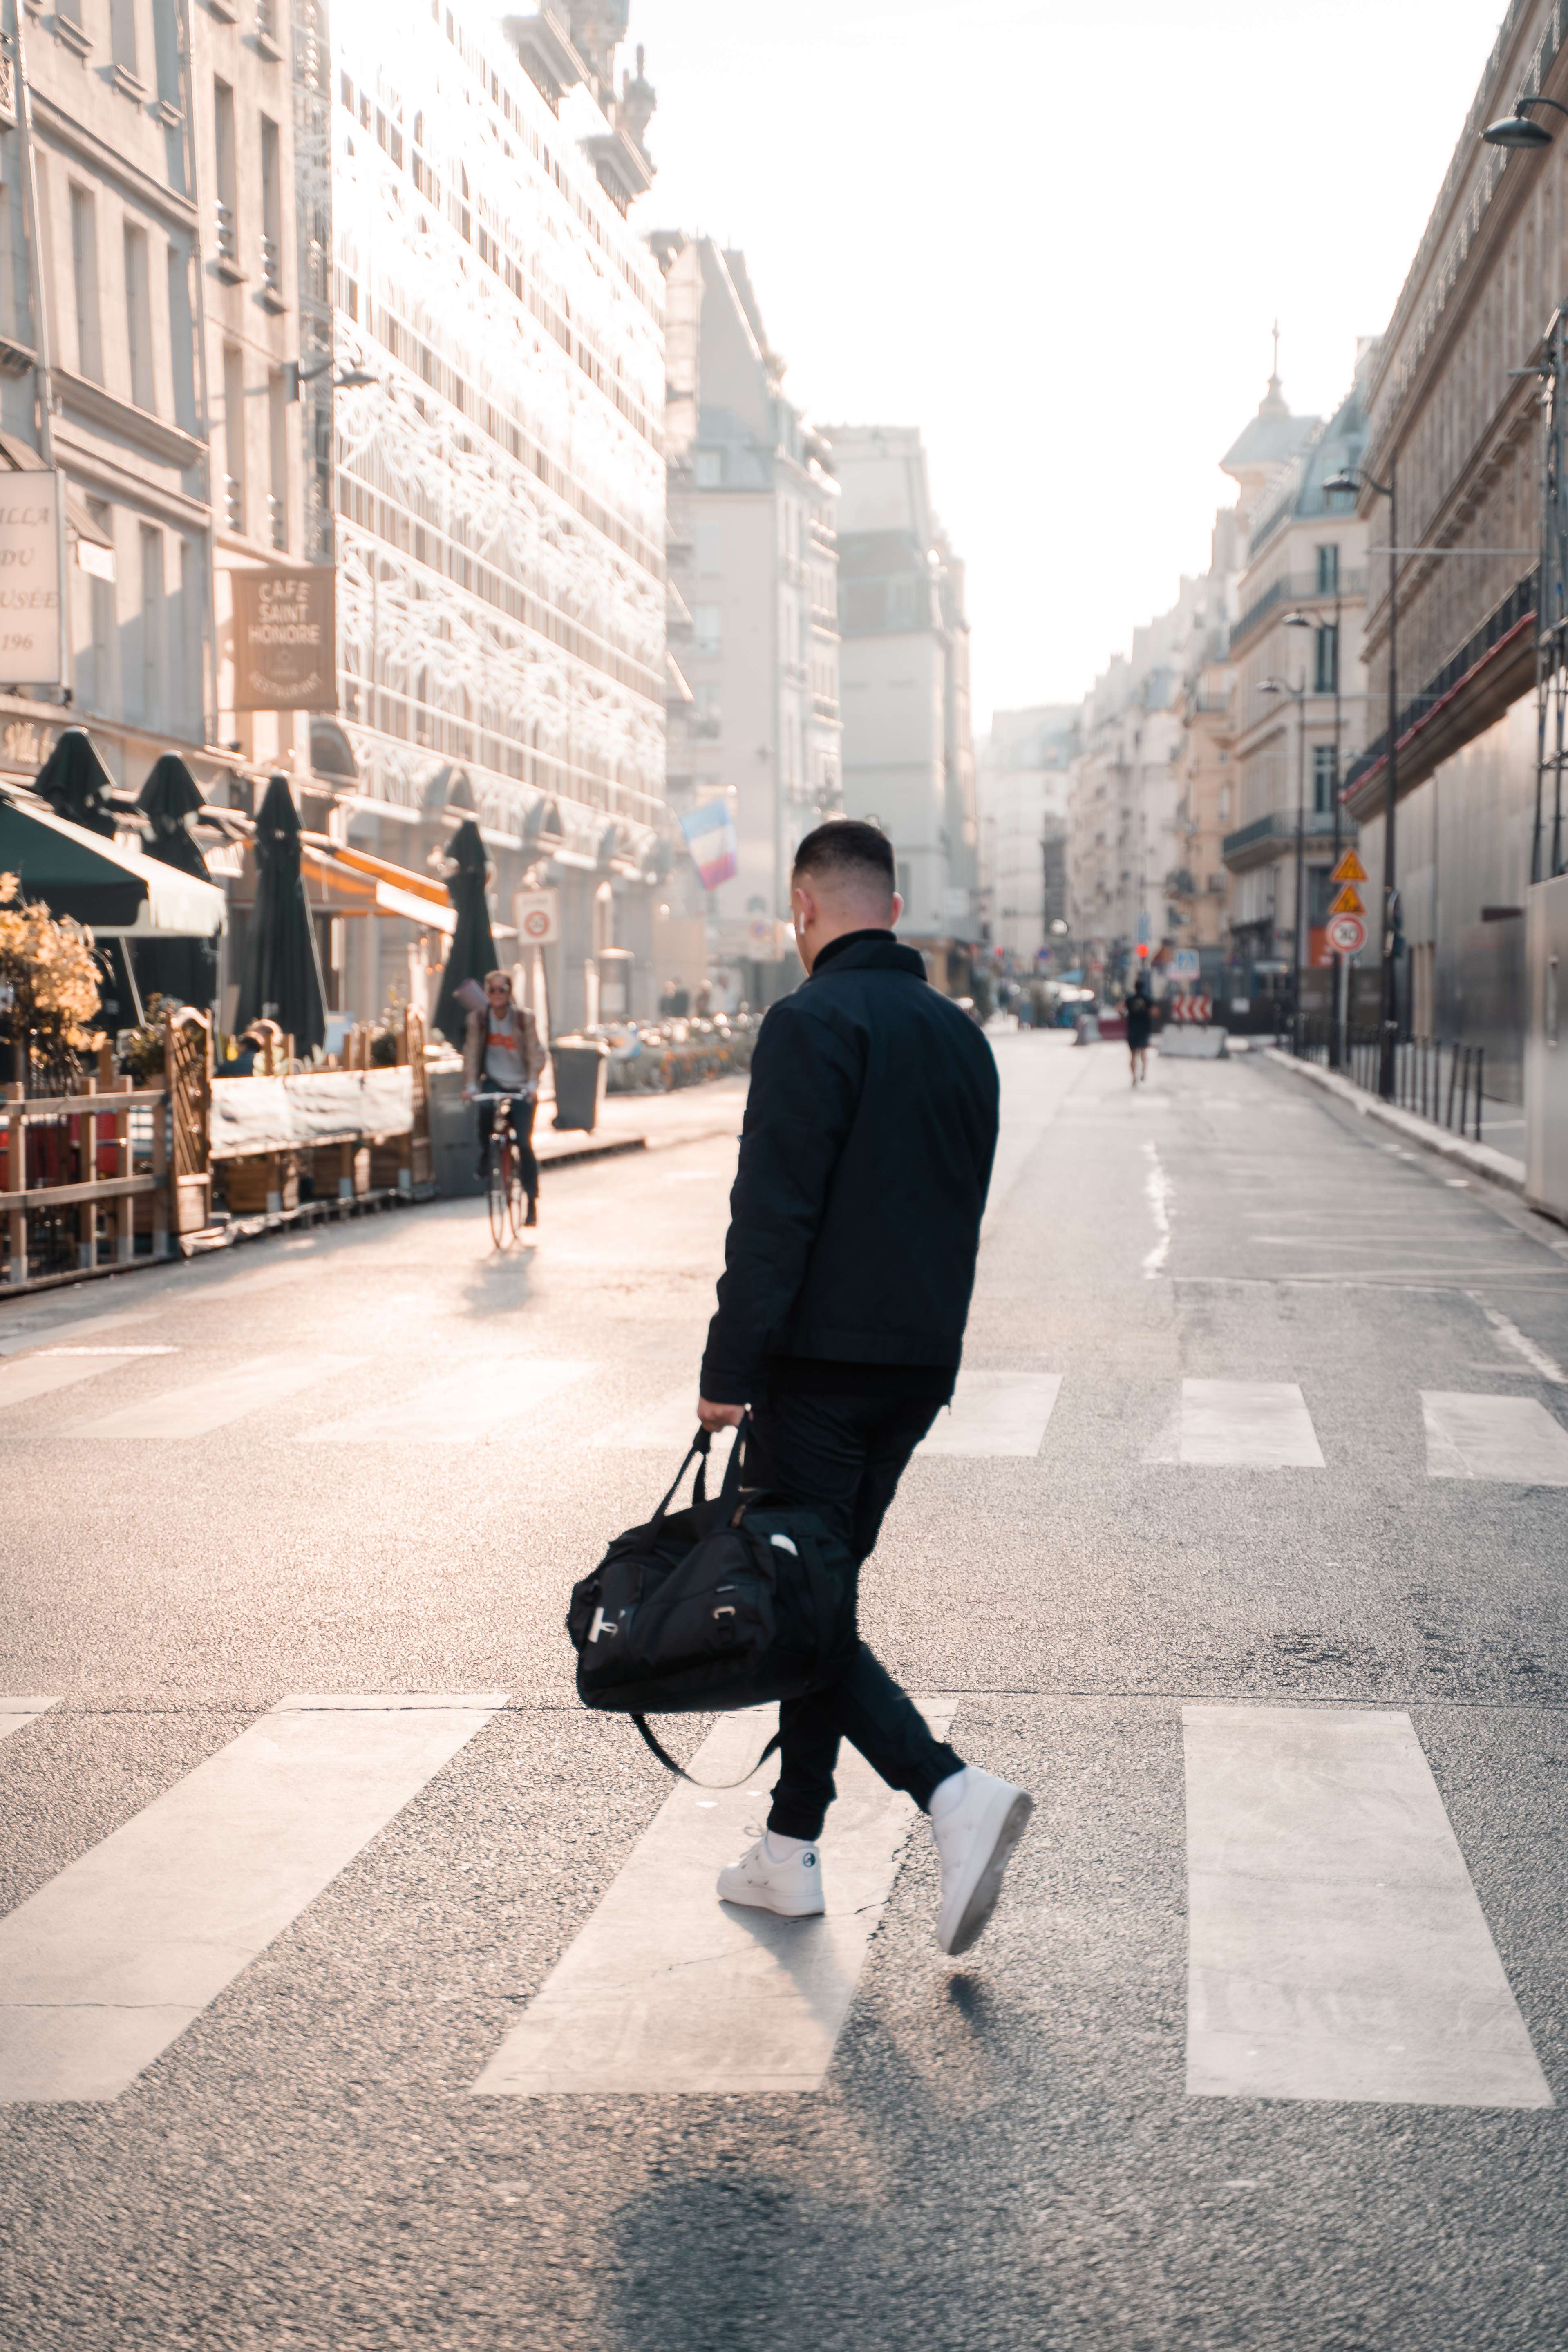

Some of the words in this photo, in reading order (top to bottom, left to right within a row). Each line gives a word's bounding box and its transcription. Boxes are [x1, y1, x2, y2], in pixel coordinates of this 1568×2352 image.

[0, 547, 36, 567] DU
[258, 603, 309, 623] SAINT
[248, 623, 320, 645] HONORE
